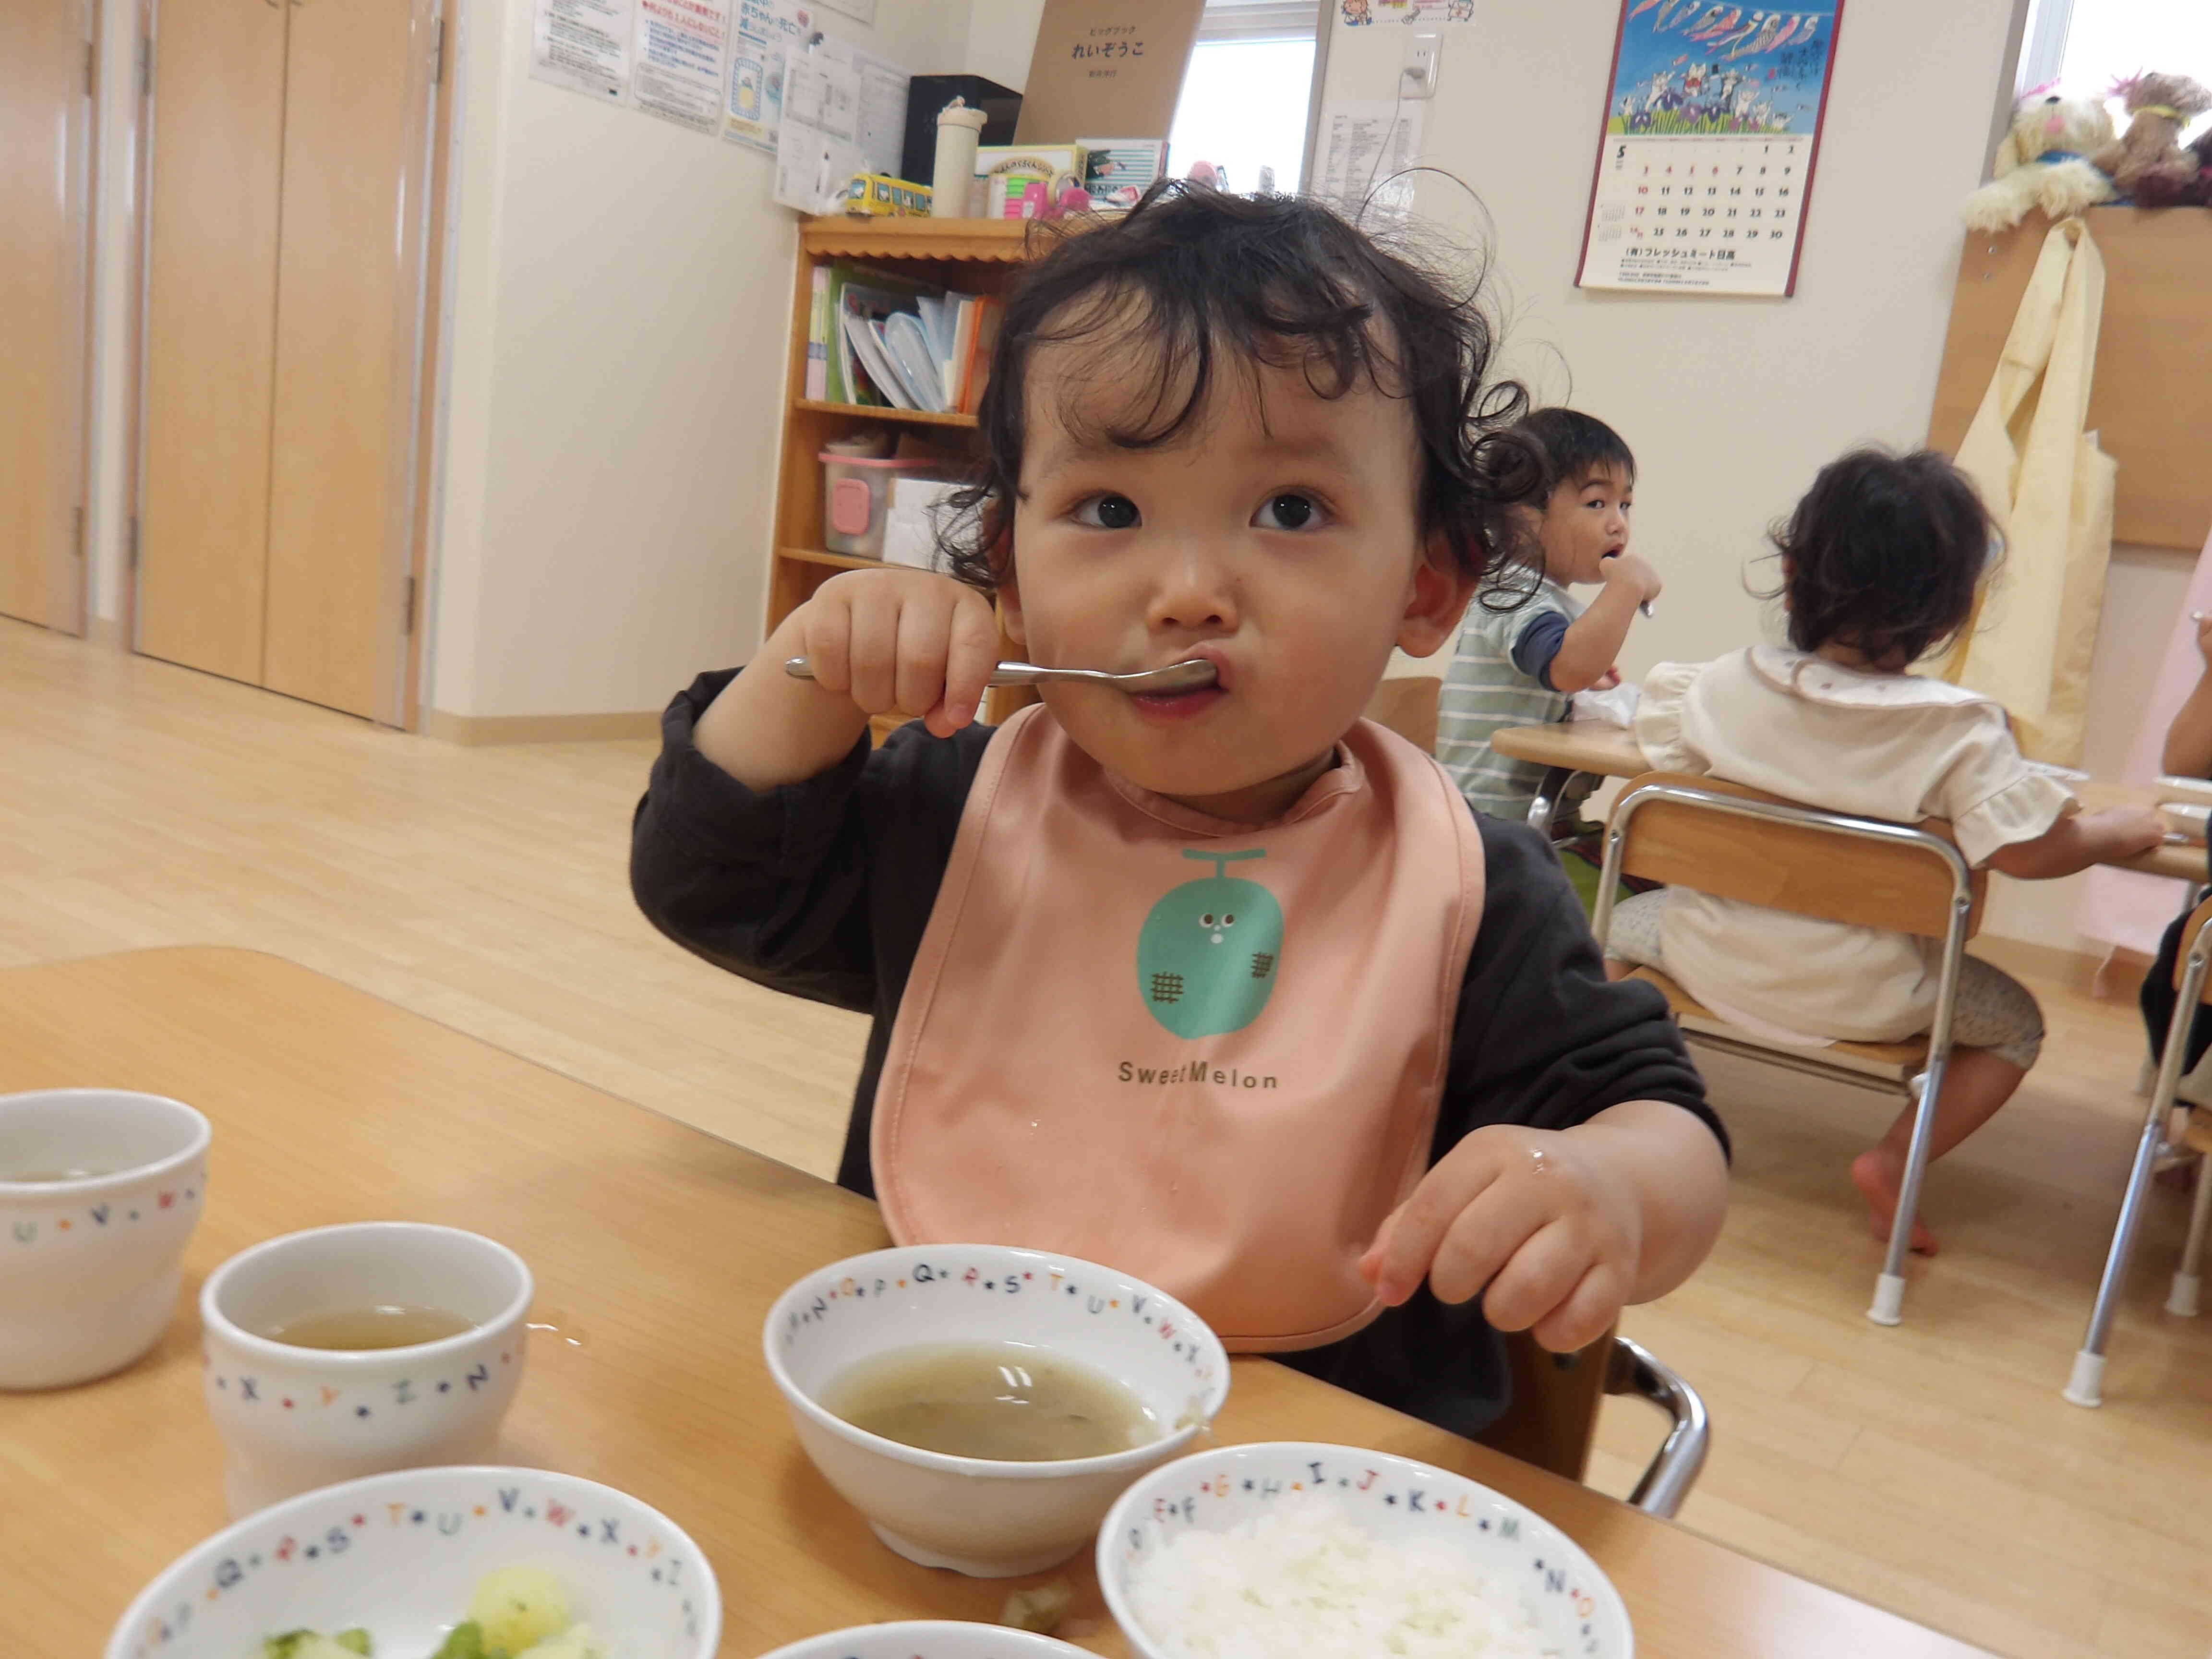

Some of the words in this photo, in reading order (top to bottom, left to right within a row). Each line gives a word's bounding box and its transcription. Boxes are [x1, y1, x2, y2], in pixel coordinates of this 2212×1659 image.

[1090, 26, 1136, 36] ビッグブック
[1072, 42, 1143, 59] れいぞうこ
[1617, 145, 1626, 158] 5
[1765, 145, 1768, 154] 1
[1789, 145, 1794, 154] 2
[1737, 166, 1743, 175] 7
[1760, 166, 1767, 175] 8
[1784, 166, 1791, 175] 9
[1637, 186, 1648, 194] 10
[1661, 187, 1670, 195] 11
[1684, 187, 1693, 195] 12
[1707, 187, 1717, 195] 13
[1730, 187, 1741, 195] 14
[1755, 188, 1765, 196] 15
[1779, 188, 1789, 196] 16
[1635, 206, 1645, 215] 17
[1658, 207, 1667, 216] 18
[1681, 207, 1690, 216] 19
[1703, 208, 1715, 216] 20
[1727, 208, 1737, 217] 21
[1750, 208, 1761, 217] 22
[1775, 209, 1785, 217] 23
[1654, 228, 1664, 236] 25
[1676, 228, 1687, 236] 26
[1699, 228, 1711, 237] 27
[1723, 229, 1734, 238] 28
[1747, 229, 1758, 238] 29
[1770, 230, 1782, 239] 30
[913, 1263, 936, 1283] Q
[1004, 1275, 1022, 1294] S
[1357, 1469, 1379, 1491] J
[1408, 1490, 1426, 1513] K
[1455, 1494, 1470, 1517] L
[498, 1488, 521, 1513] V
